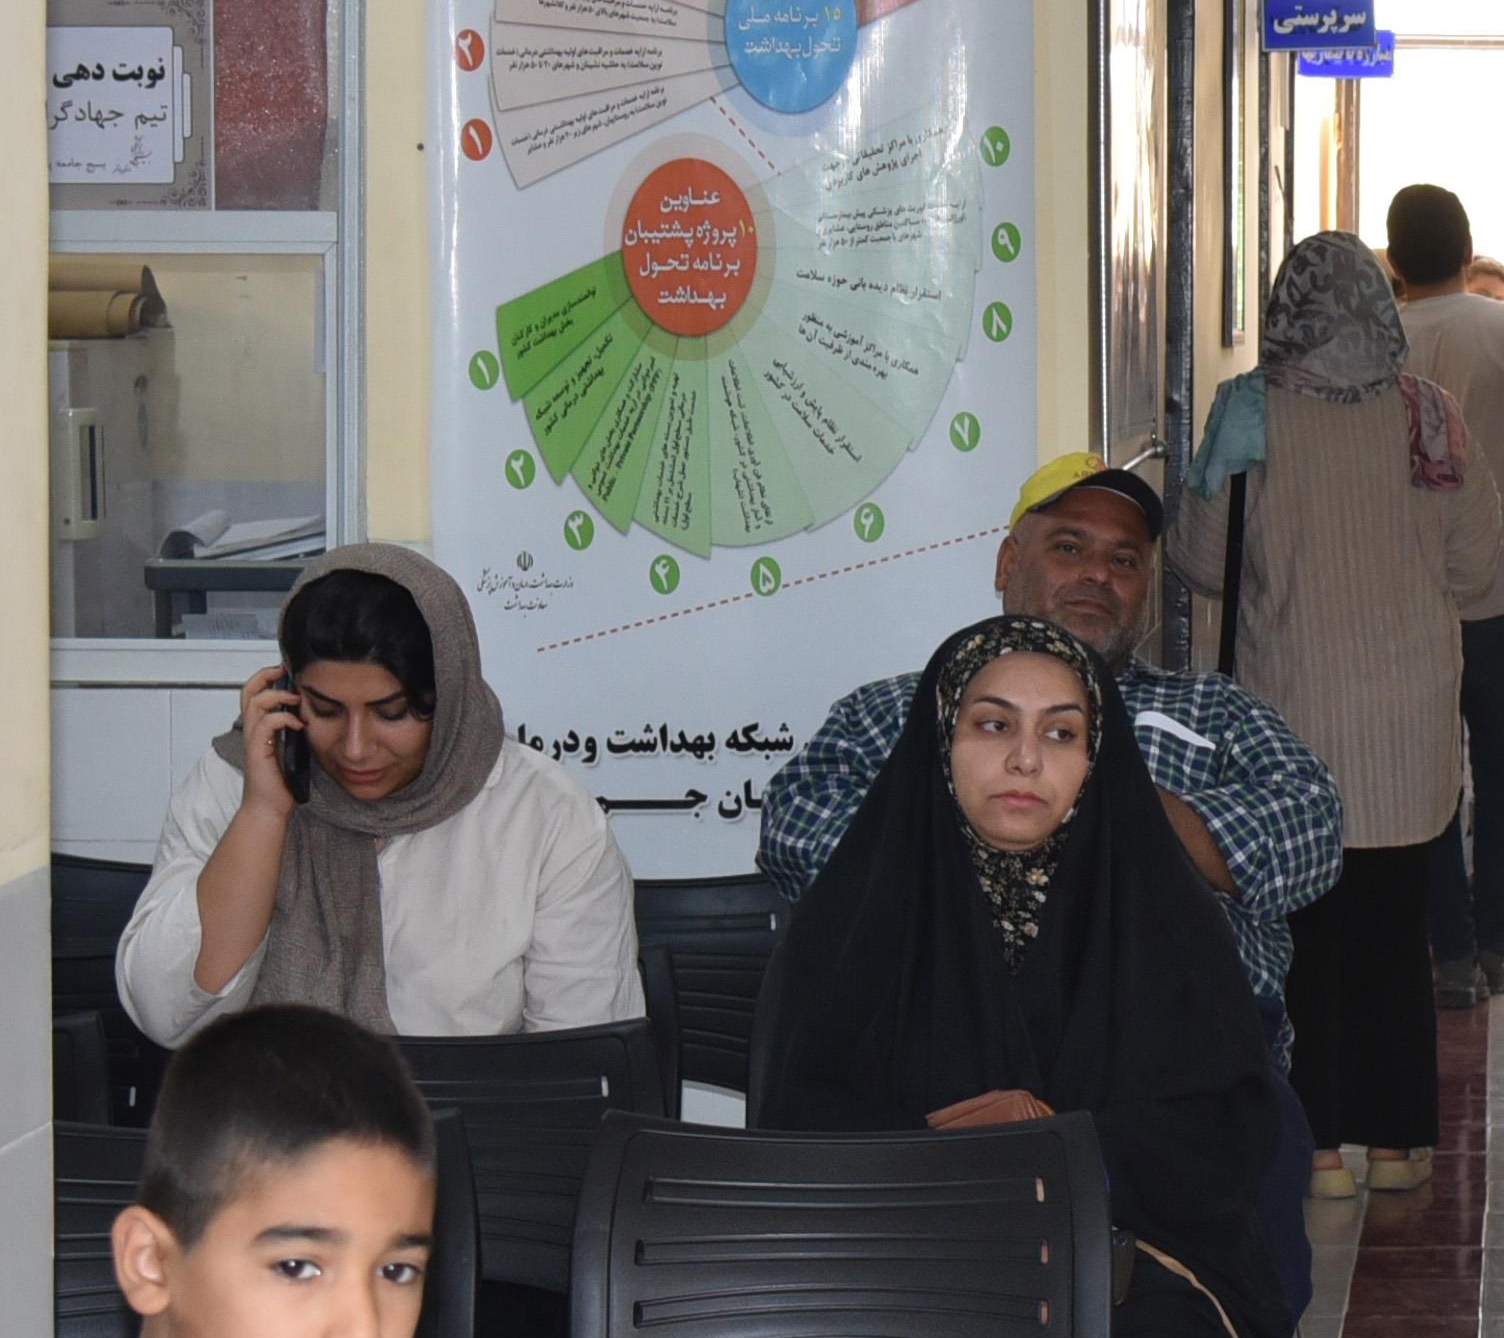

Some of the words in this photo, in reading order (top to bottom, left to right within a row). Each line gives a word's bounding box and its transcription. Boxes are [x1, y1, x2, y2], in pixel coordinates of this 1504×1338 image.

[738, 6, 771, 31] ملی
[774, 6, 819, 29] برنامه
[824, 6, 842, 21] ۱۵
[744, 36, 801, 59] بهداشت
[802, 36, 841, 58] تحول
[52, 62, 105, 88] دهی
[112, 57, 166, 89] نوبت
[135, 105, 168, 130] تیم
[660, 186, 721, 213] عناوین
[625, 220, 694, 248] پشتیبان
[696, 220, 737, 248] پروژه
[738, 219, 754, 238] ۱۰
[639, 253, 690, 278] تحول
[692, 252, 741, 278] برنامه
[657, 285, 727, 310] بهداشت
[606, 722, 716, 761] بهداشت
[725, 722, 794, 762] شبکه
